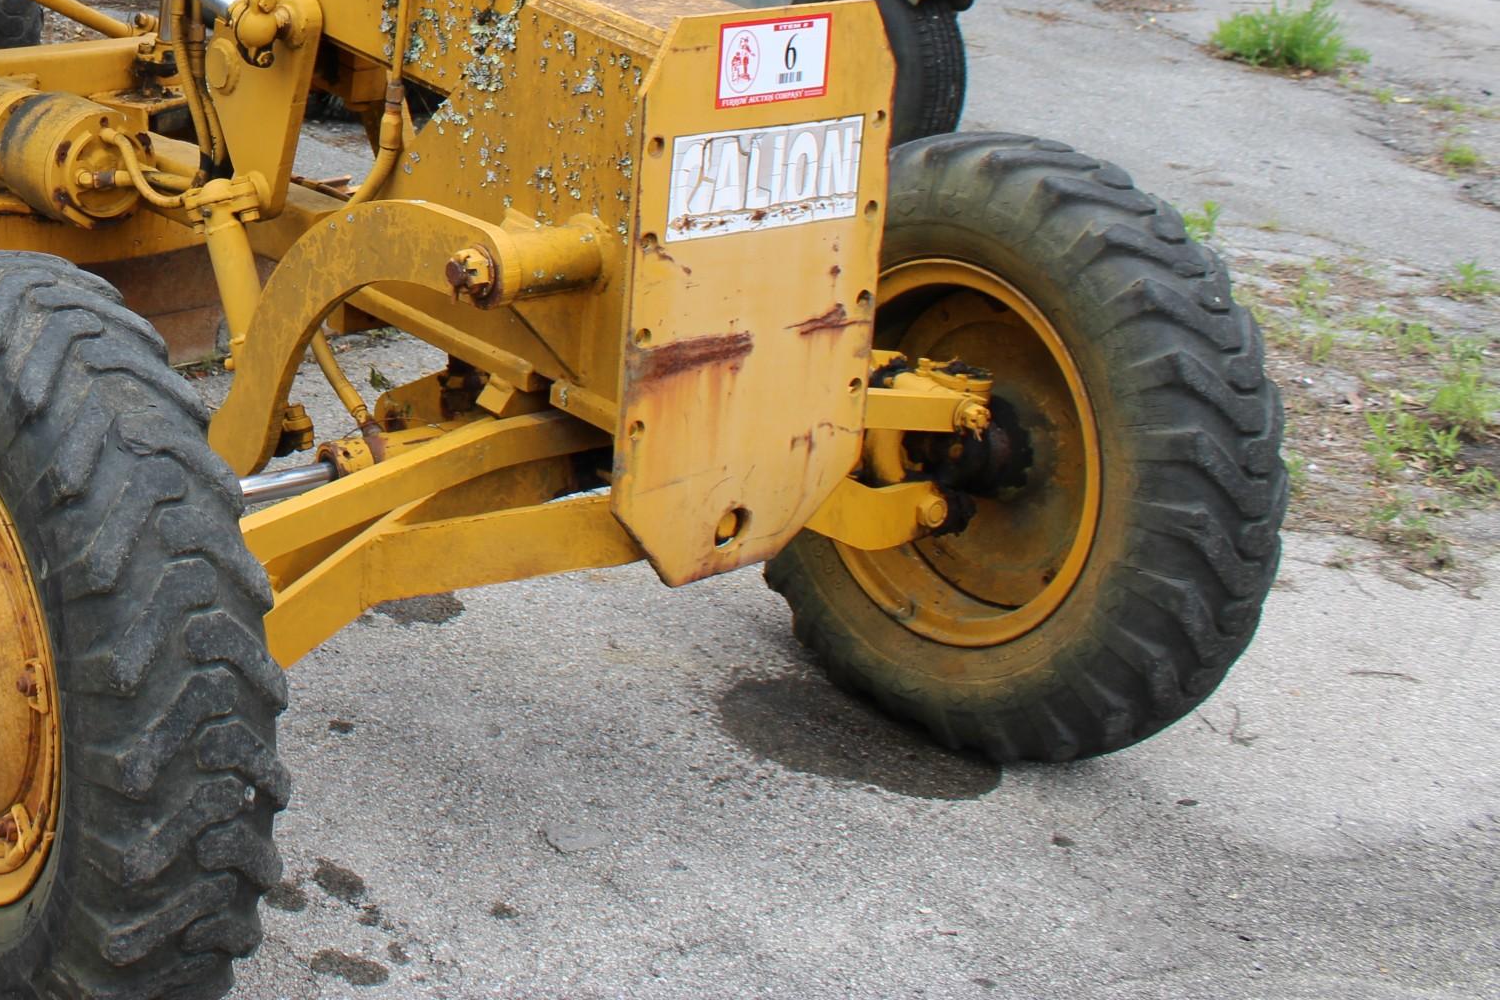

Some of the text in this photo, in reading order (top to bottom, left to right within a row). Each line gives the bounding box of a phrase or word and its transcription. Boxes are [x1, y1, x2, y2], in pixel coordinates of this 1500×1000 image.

[778, 23, 802, 31] ITEM
[785, 33, 799, 71] 6
[747, 93, 774, 105] AUCTION
[774, 89, 805, 101] COMPANY
